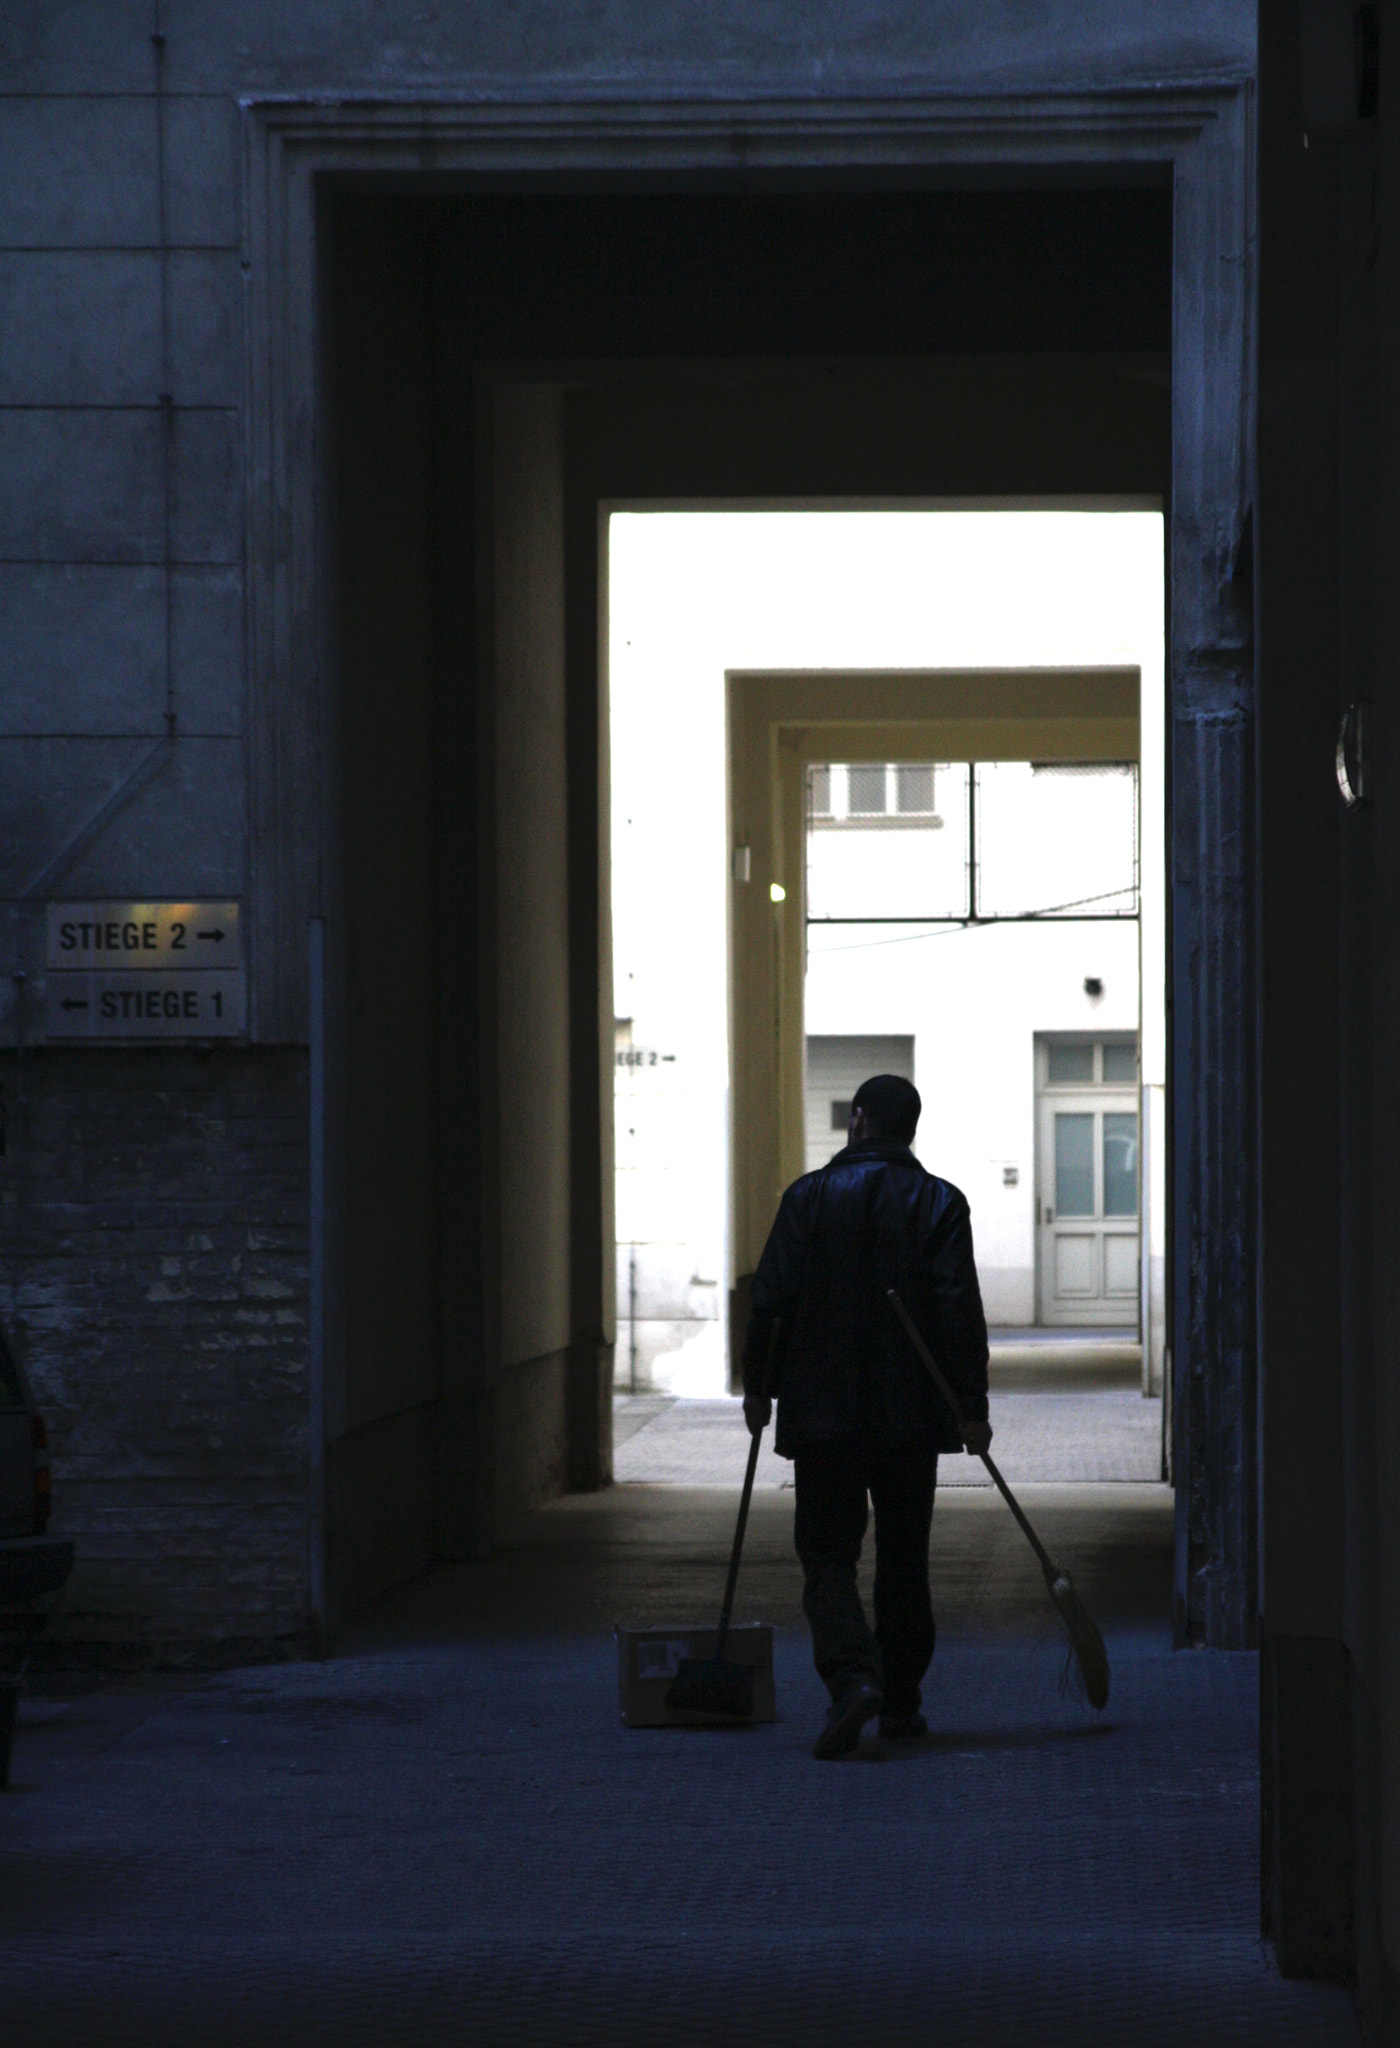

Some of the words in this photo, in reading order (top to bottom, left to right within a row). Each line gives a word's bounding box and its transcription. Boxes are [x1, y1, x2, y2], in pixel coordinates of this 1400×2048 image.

[60, 922, 158, 950] STIEGE
[170, 922, 187, 950] 2
[101, 990, 199, 1019] STIEGE
[211, 991, 224, 1019] 1
[649, 1051, 658, 1067] 2
